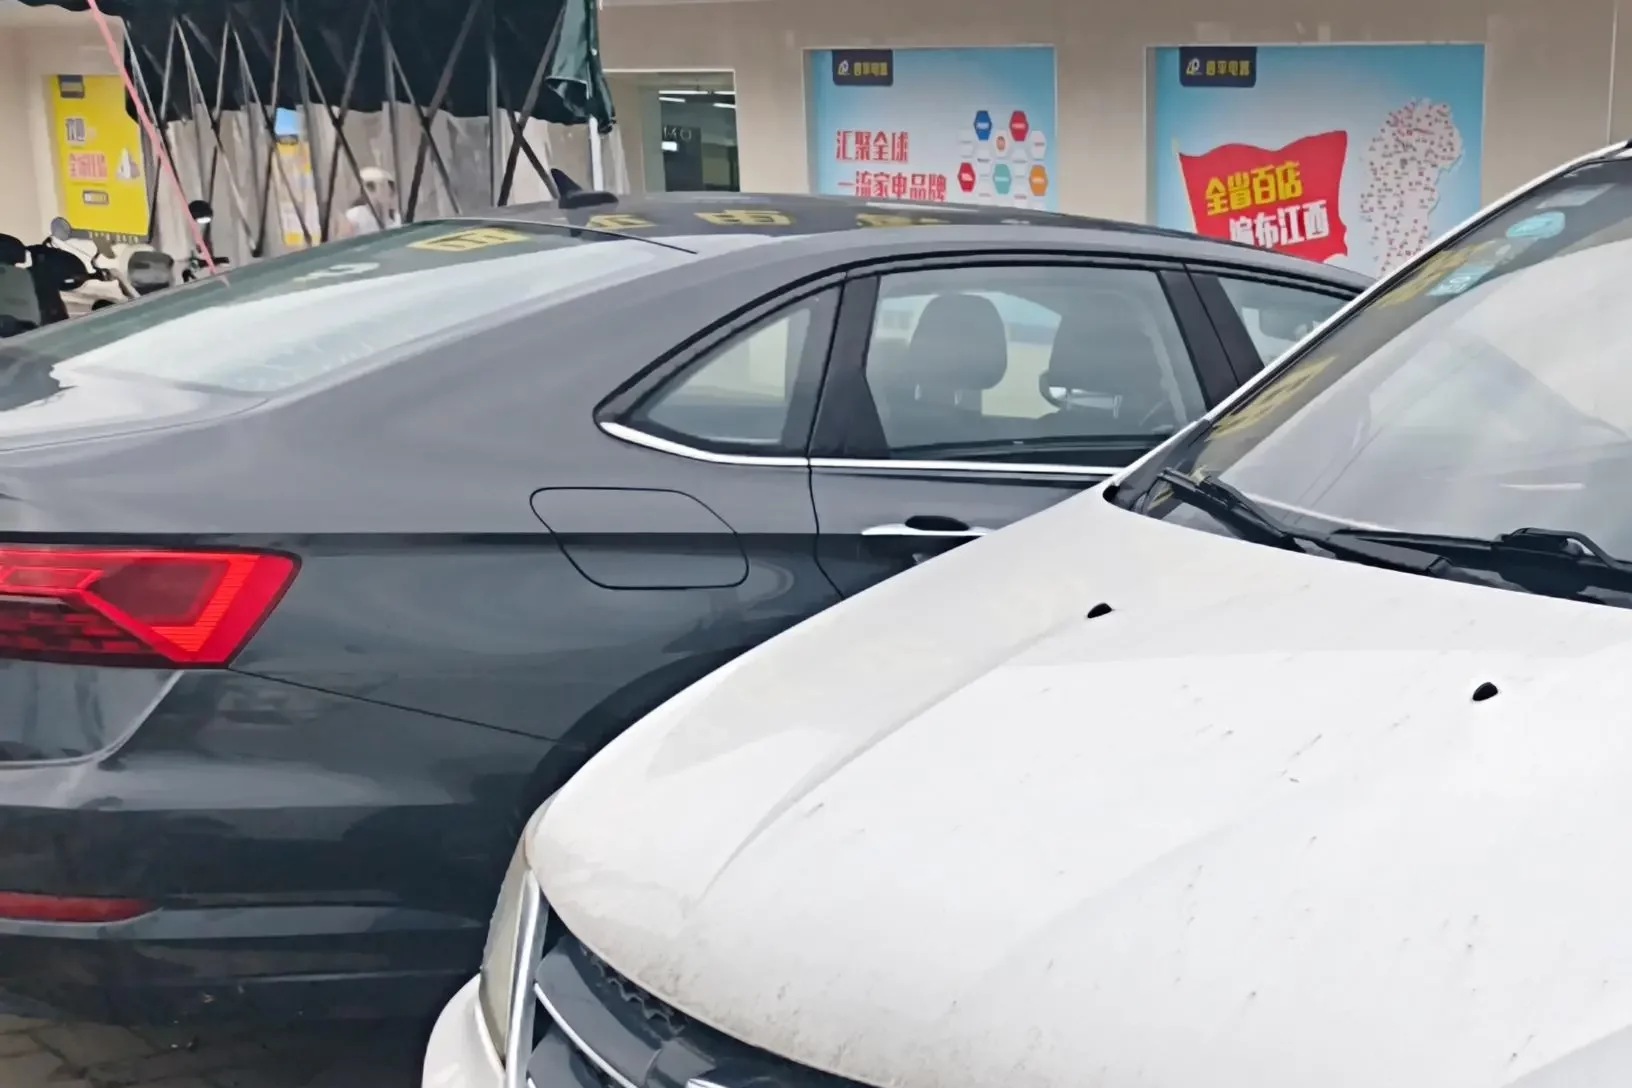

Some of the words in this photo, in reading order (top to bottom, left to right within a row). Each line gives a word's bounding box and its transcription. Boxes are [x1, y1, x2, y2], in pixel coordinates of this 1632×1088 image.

[836, 130, 908, 161] 汇聚全球
[837, 171, 947, 202] 一流家电品牌
[1205, 160, 1303, 216] 全省百店
